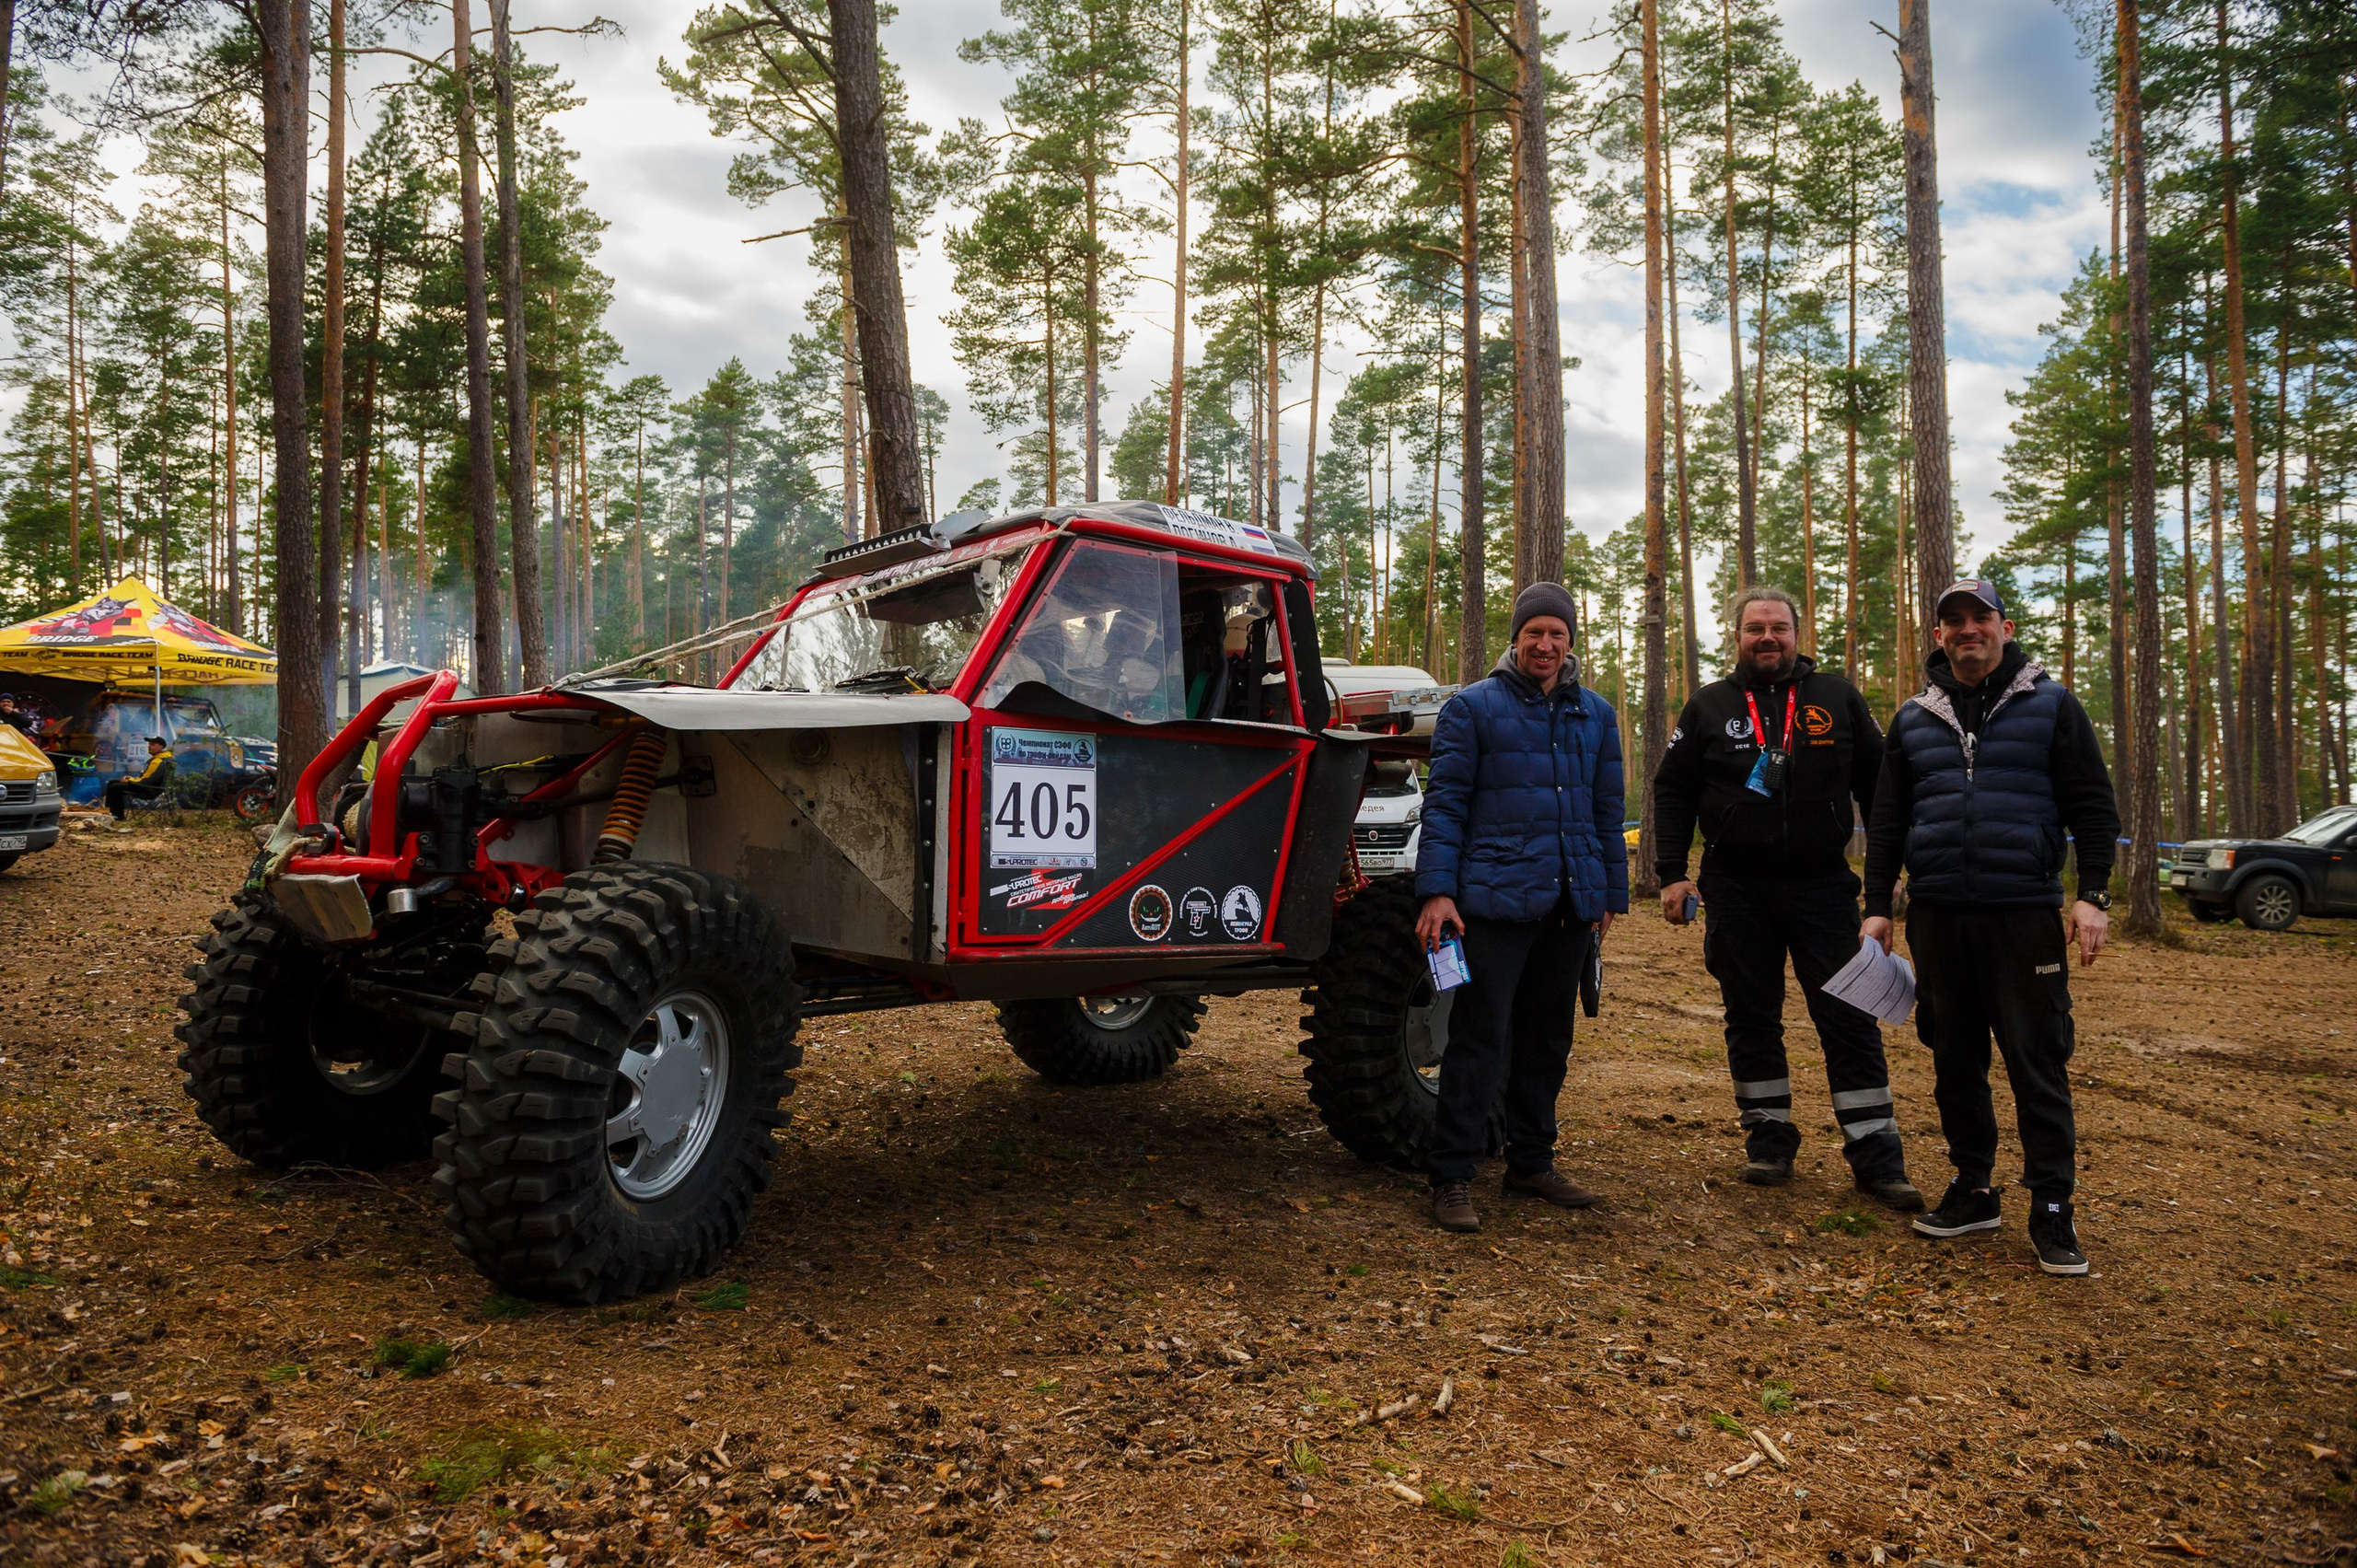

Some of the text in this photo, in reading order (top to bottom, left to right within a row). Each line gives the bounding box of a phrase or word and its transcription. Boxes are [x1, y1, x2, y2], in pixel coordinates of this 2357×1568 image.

[1162, 506, 1227, 532] ФЕЛЬДМАН
[23, 634, 99, 643] BRIDGE
[177, 653, 278, 673] BRIDGE RACE TEA
[129, 746, 145, 755] 216
[995, 782, 1090, 840] 405
[1006, 877, 1082, 907] COMFORT
[2036, 962, 2061, 975] PUMA
